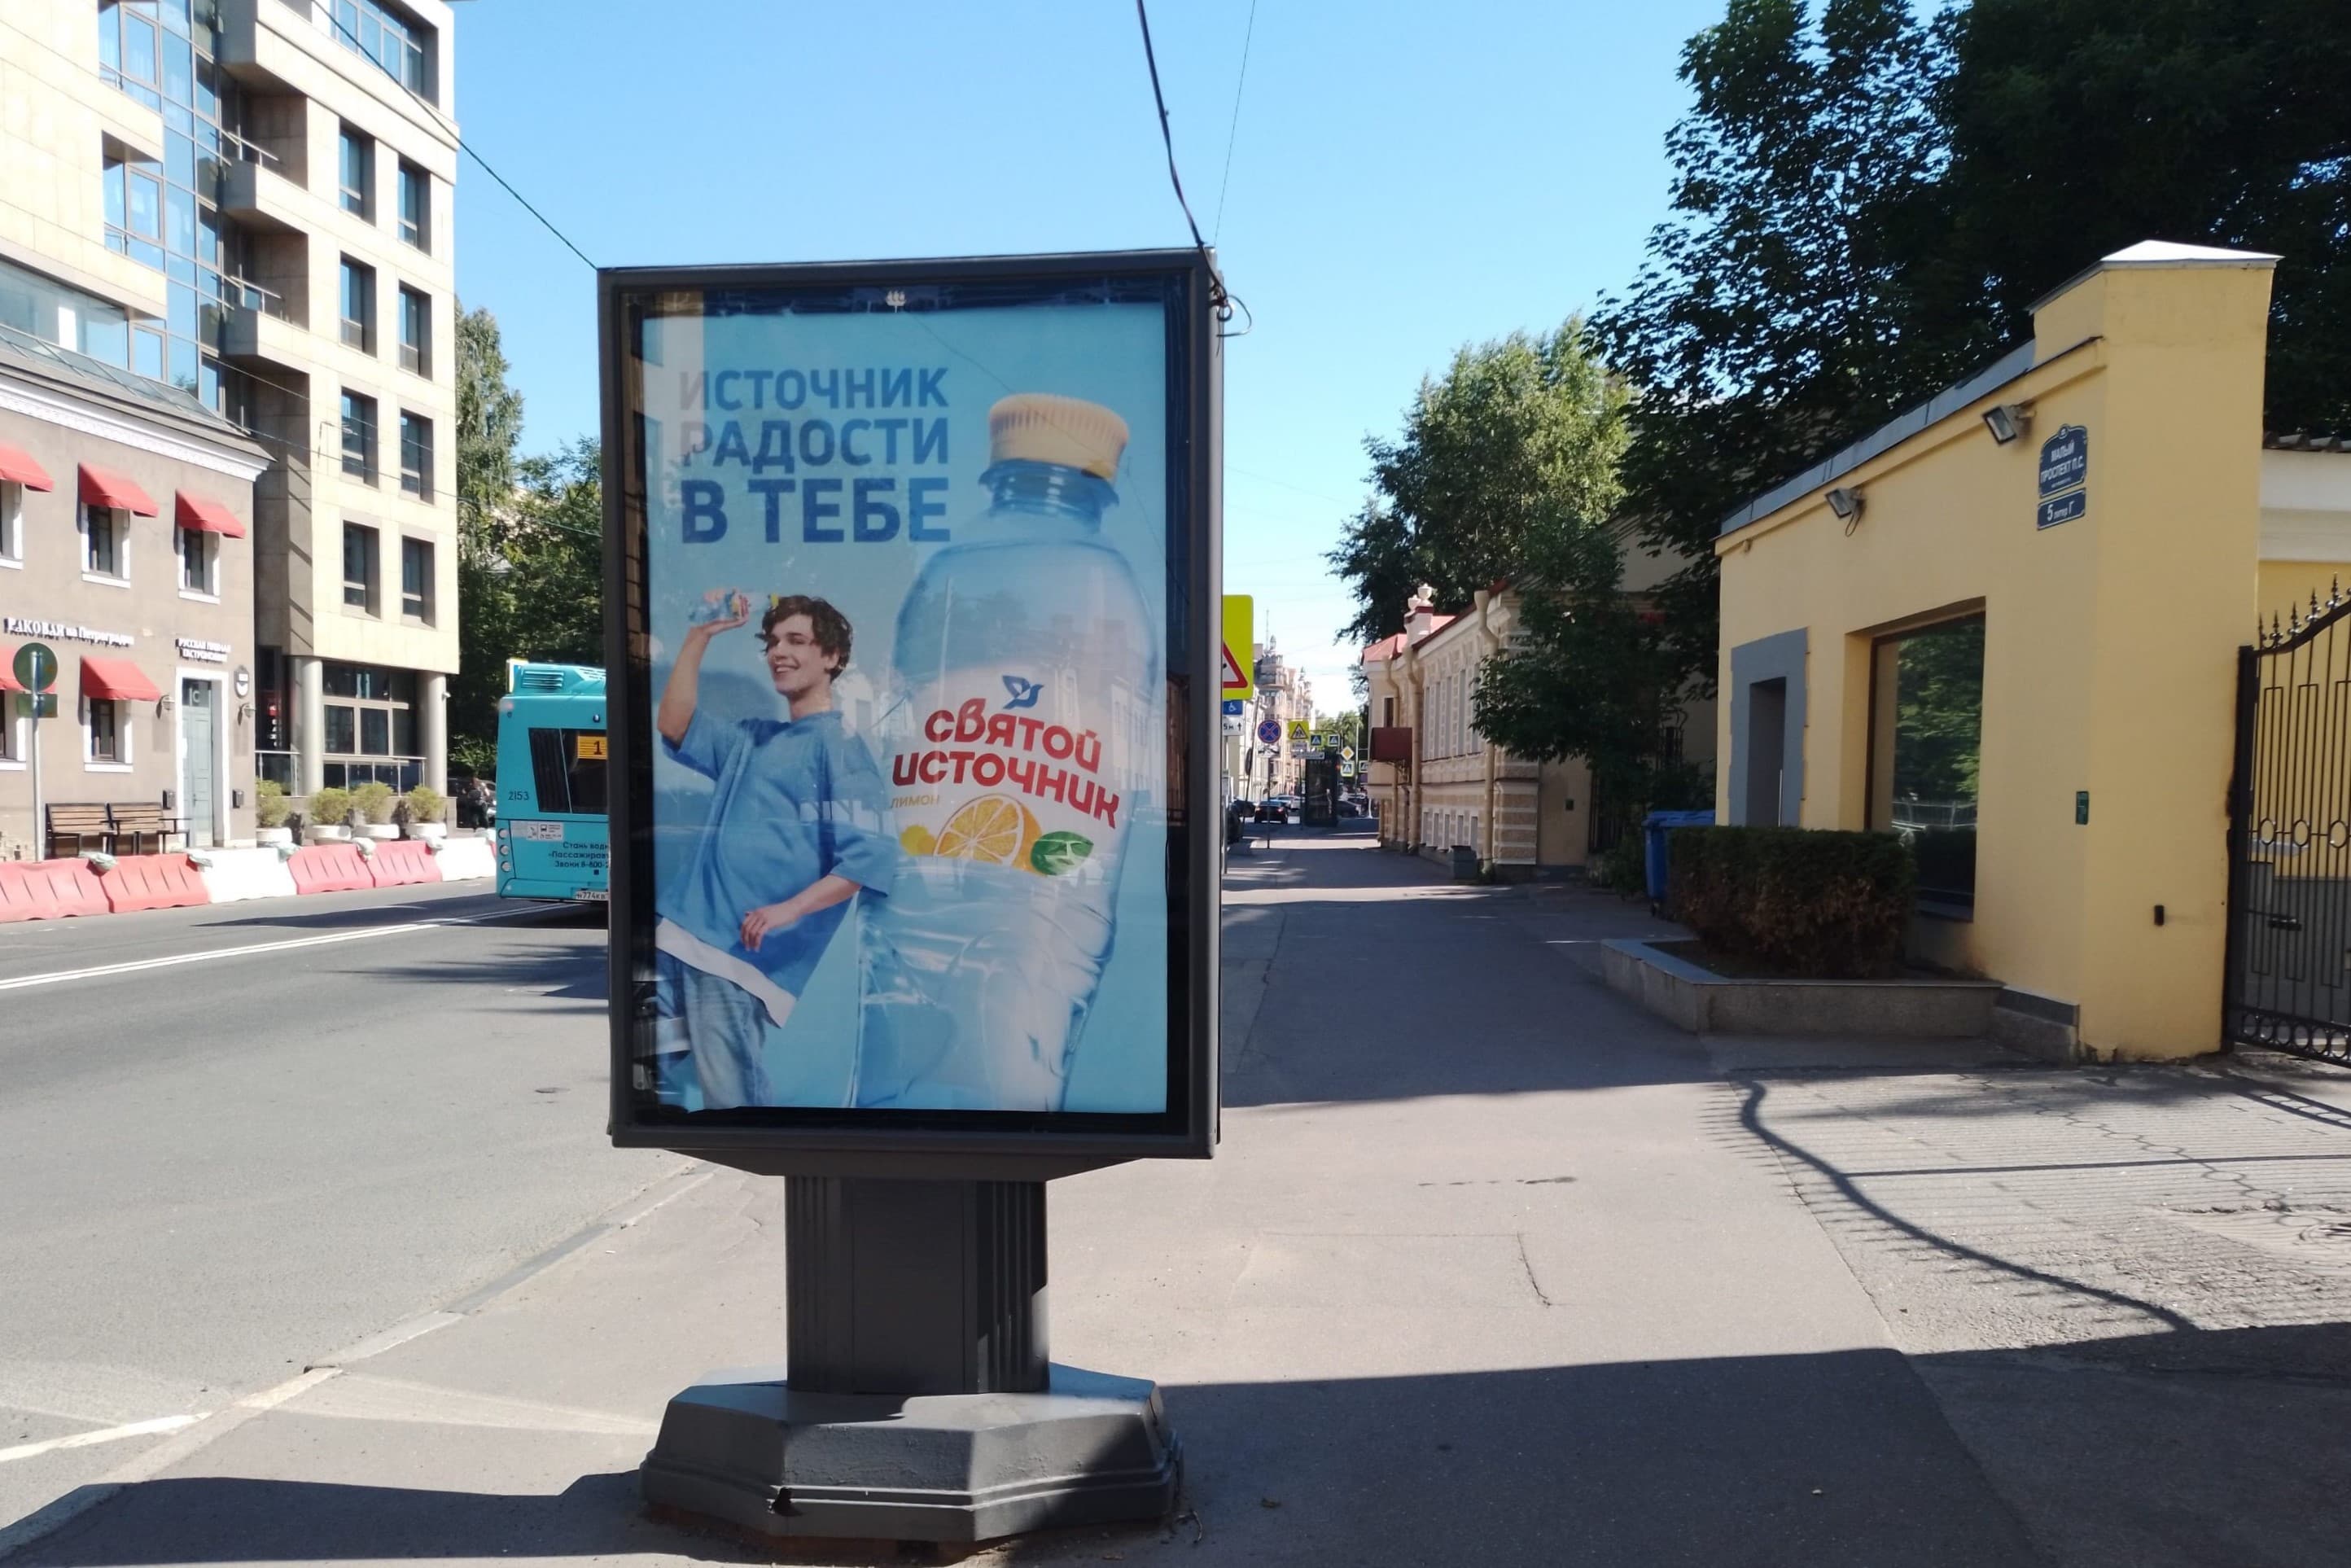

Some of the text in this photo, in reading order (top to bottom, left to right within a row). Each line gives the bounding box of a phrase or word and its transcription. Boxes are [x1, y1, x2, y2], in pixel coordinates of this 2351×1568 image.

[680, 367, 948, 410] ИСТОЧНИК
[681, 417, 948, 475] РАДОСТИ
[2051, 440, 2074, 462] МАЛЫЙ
[2041, 461, 2072, 483] ПРОСПЕКТ
[681, 477, 951, 544] В ТЕБЕ
[2047, 504, 2053, 521] 5
[2069, 501, 2075, 515] Г
[508, 791, 529, 801] 2153
[563, 841, 587, 849] Стань
[554, 860, 580, 868] Звони
